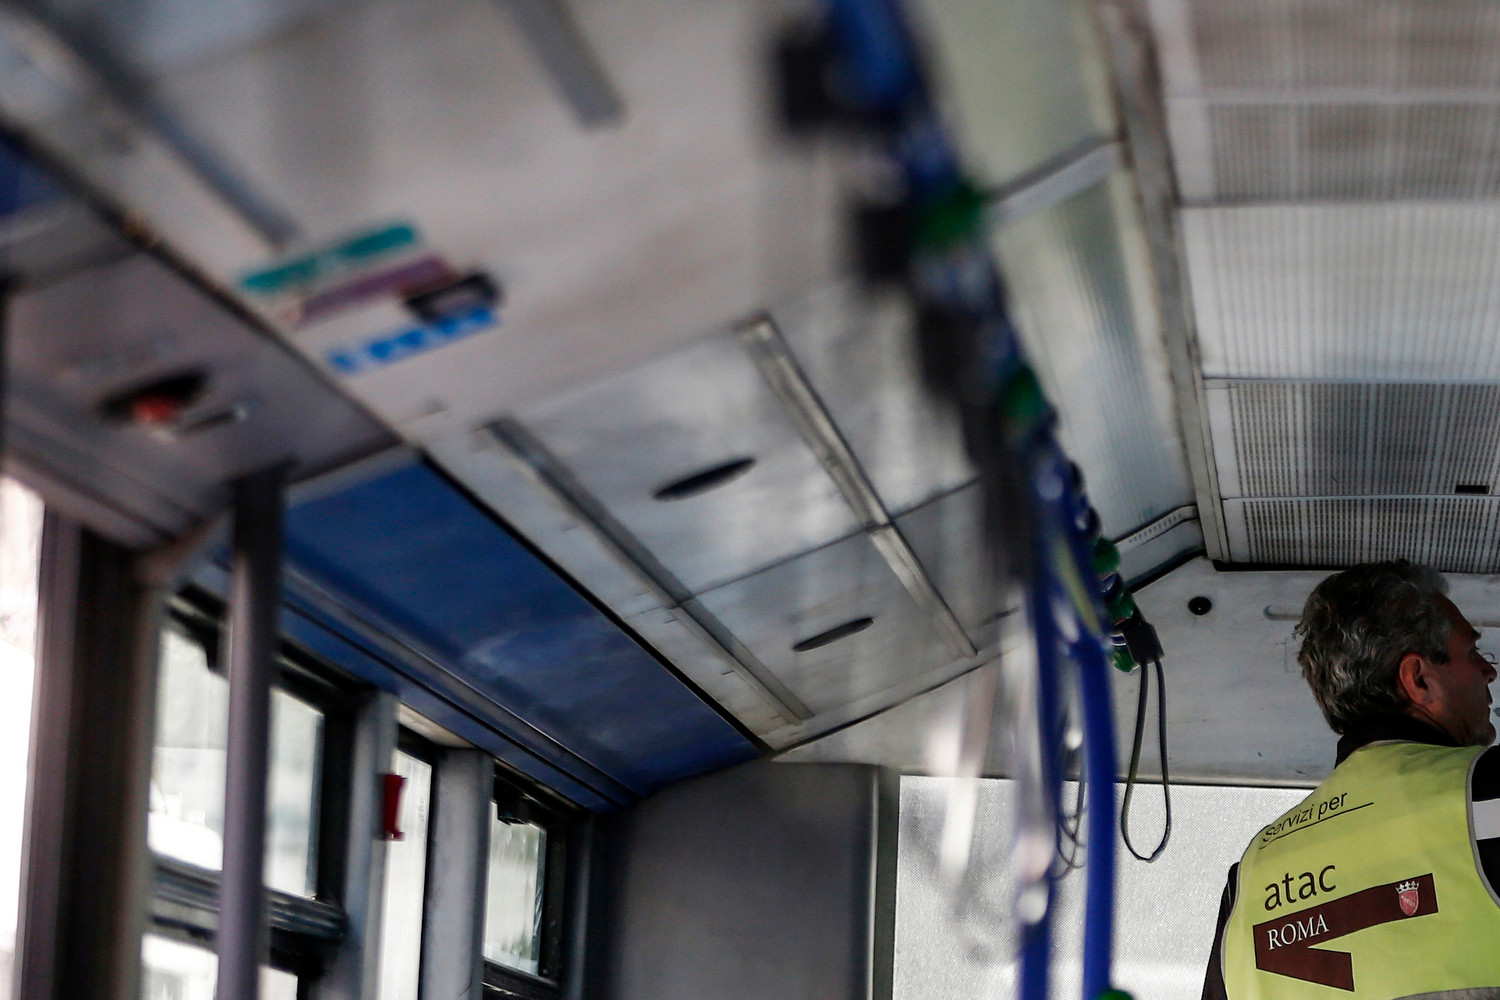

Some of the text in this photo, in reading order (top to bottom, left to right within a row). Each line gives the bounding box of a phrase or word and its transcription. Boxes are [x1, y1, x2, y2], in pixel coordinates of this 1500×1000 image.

[1318, 792, 1348, 820] per
[1264, 864, 1336, 911] atac
[1267, 914, 1329, 950] ROMA
